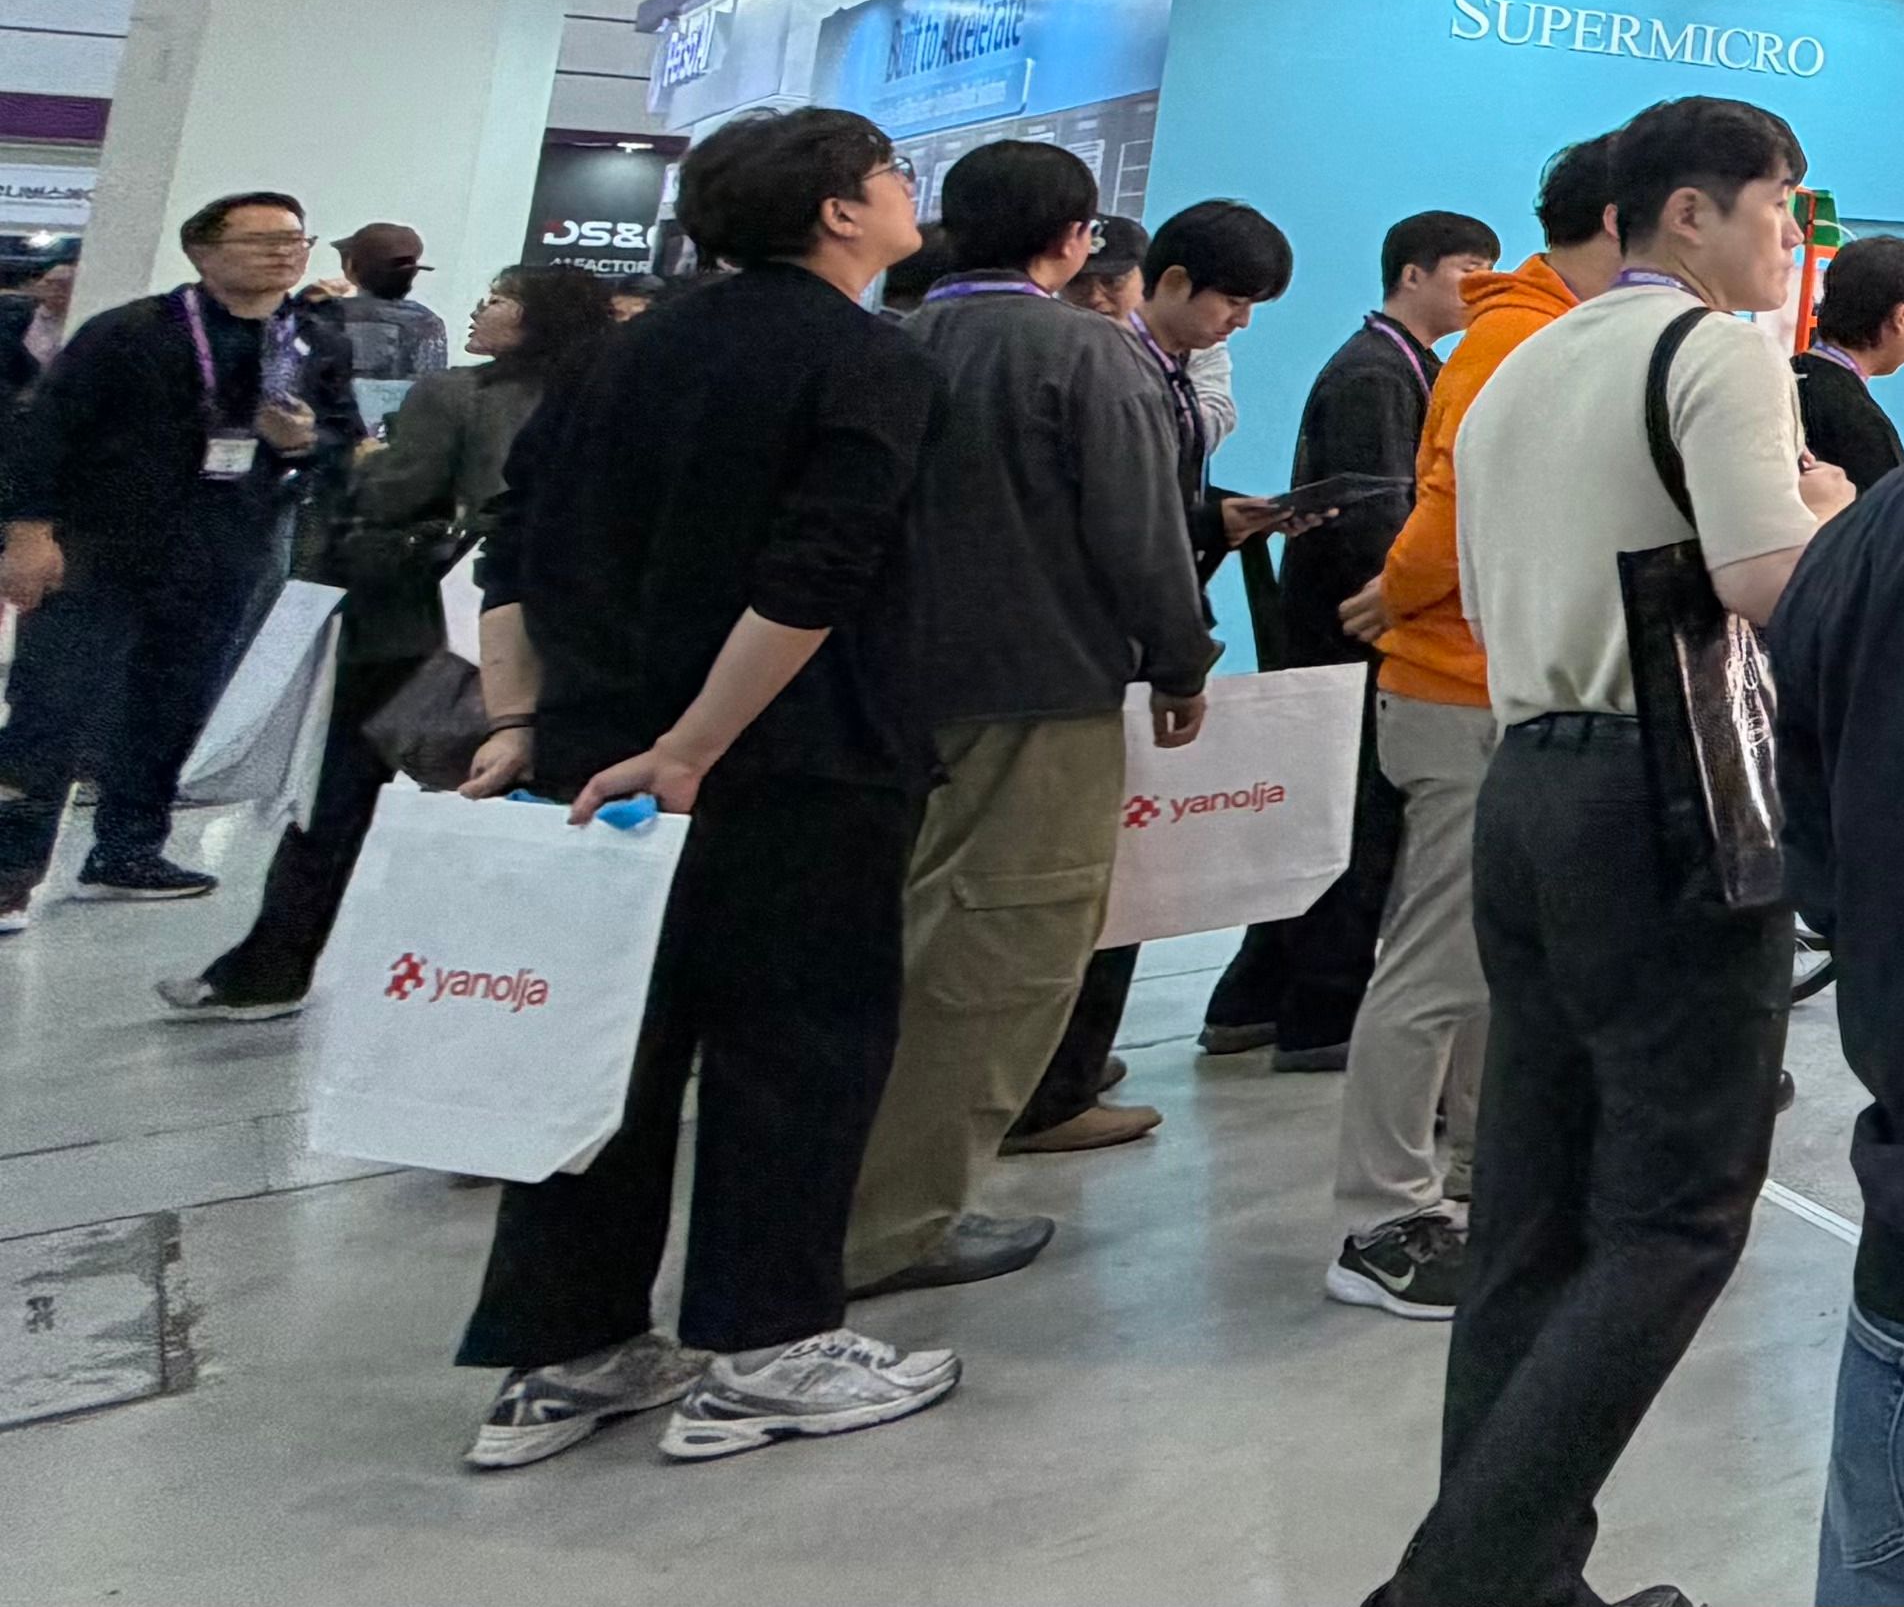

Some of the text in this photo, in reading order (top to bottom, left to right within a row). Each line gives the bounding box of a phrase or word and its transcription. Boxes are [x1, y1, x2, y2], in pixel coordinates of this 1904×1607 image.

[539, 220, 658, 249] DS&
[1170, 781, 1287, 823] yanolja
[429, 967, 551, 1013] yanolja
